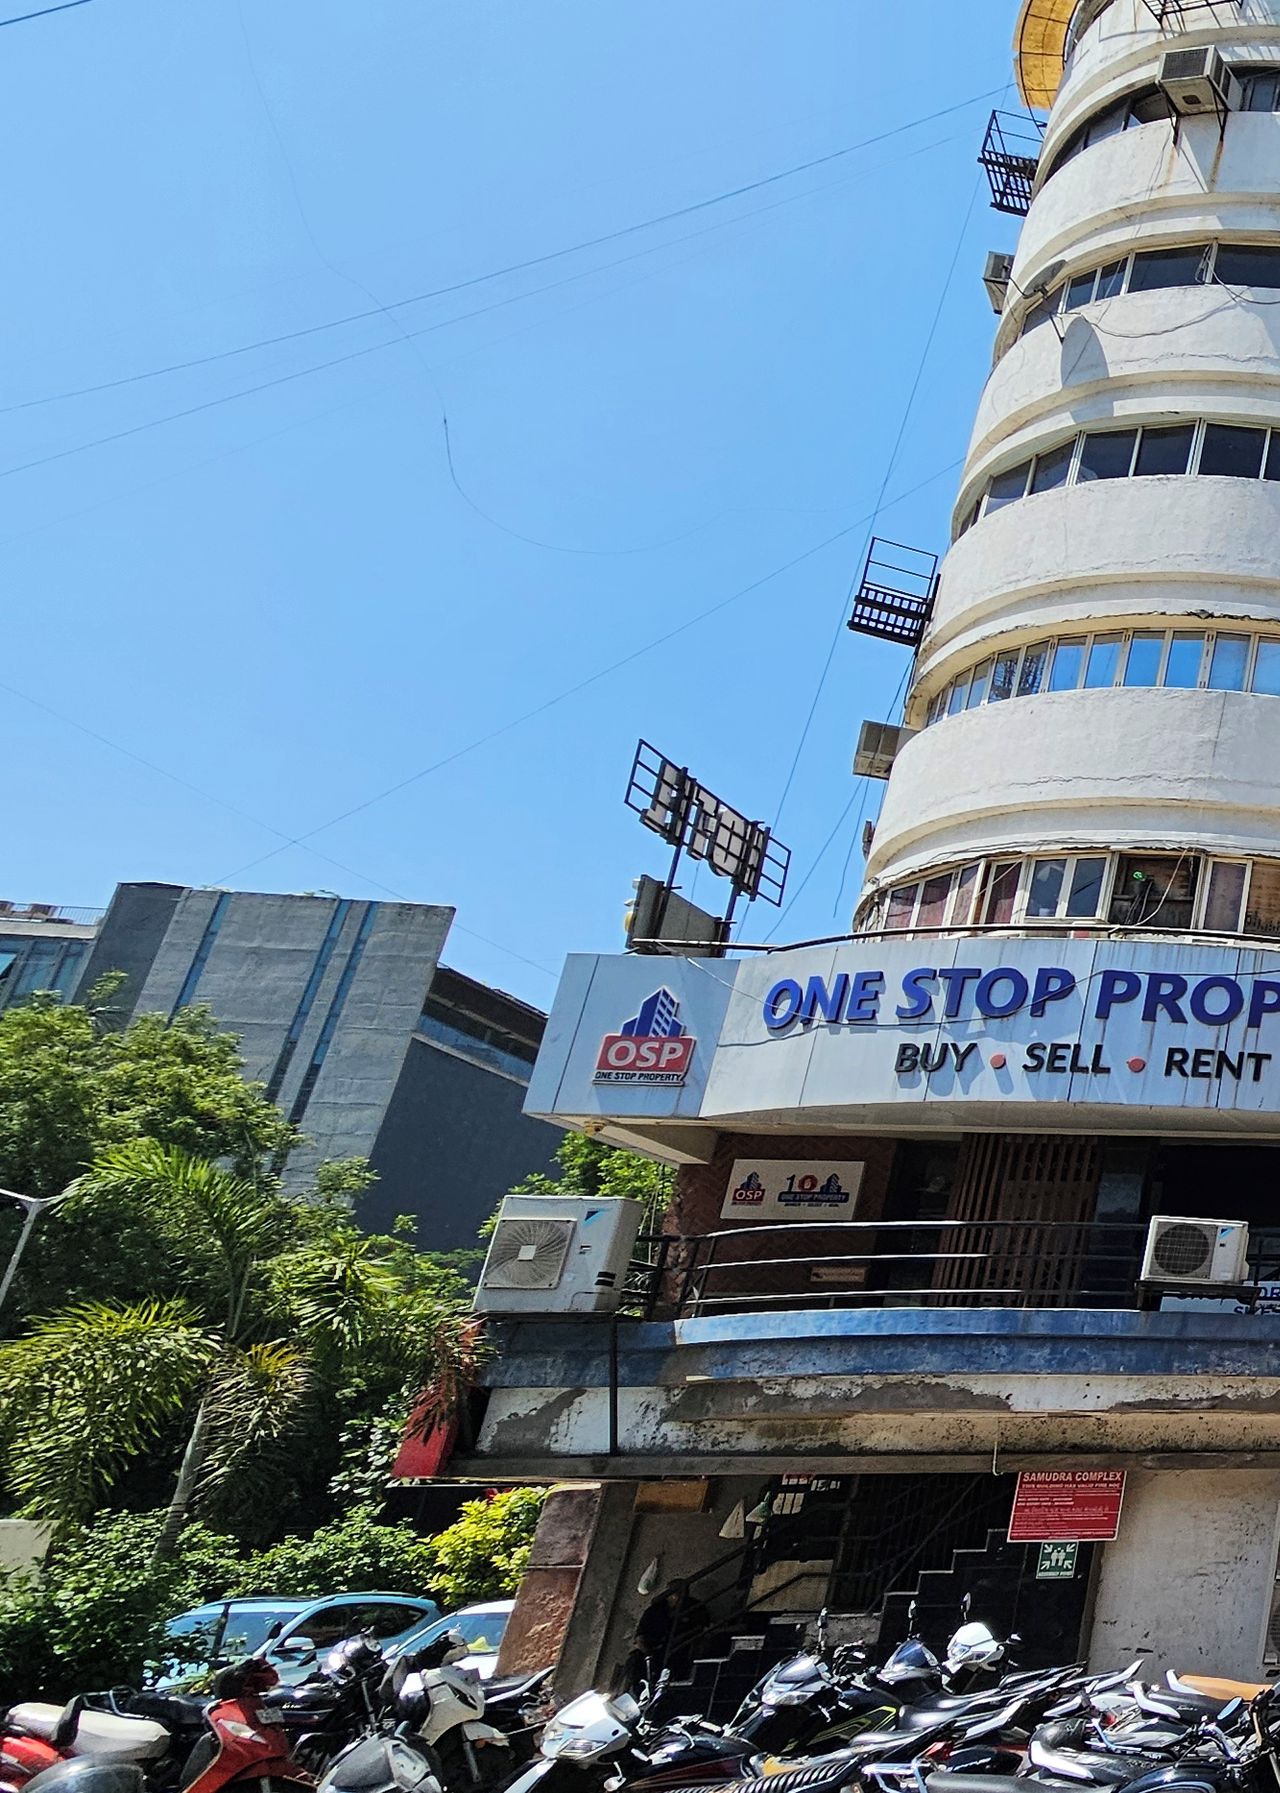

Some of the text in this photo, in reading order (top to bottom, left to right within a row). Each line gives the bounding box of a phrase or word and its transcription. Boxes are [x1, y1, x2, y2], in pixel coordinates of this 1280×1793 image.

[762, 970, 885, 1030] ONE
[895, 966, 1076, 1021] STOP
[607, 1039, 685, 1069] OSP
[894, 1042, 1272, 1082] BUY SELL RENT
[595, 1071, 682, 1082] ONE STOP PROPERTY
[735, 1190, 762, 1200] OSP
[1023, 1471, 1122, 1482] SAMUDRA COMPLEX
